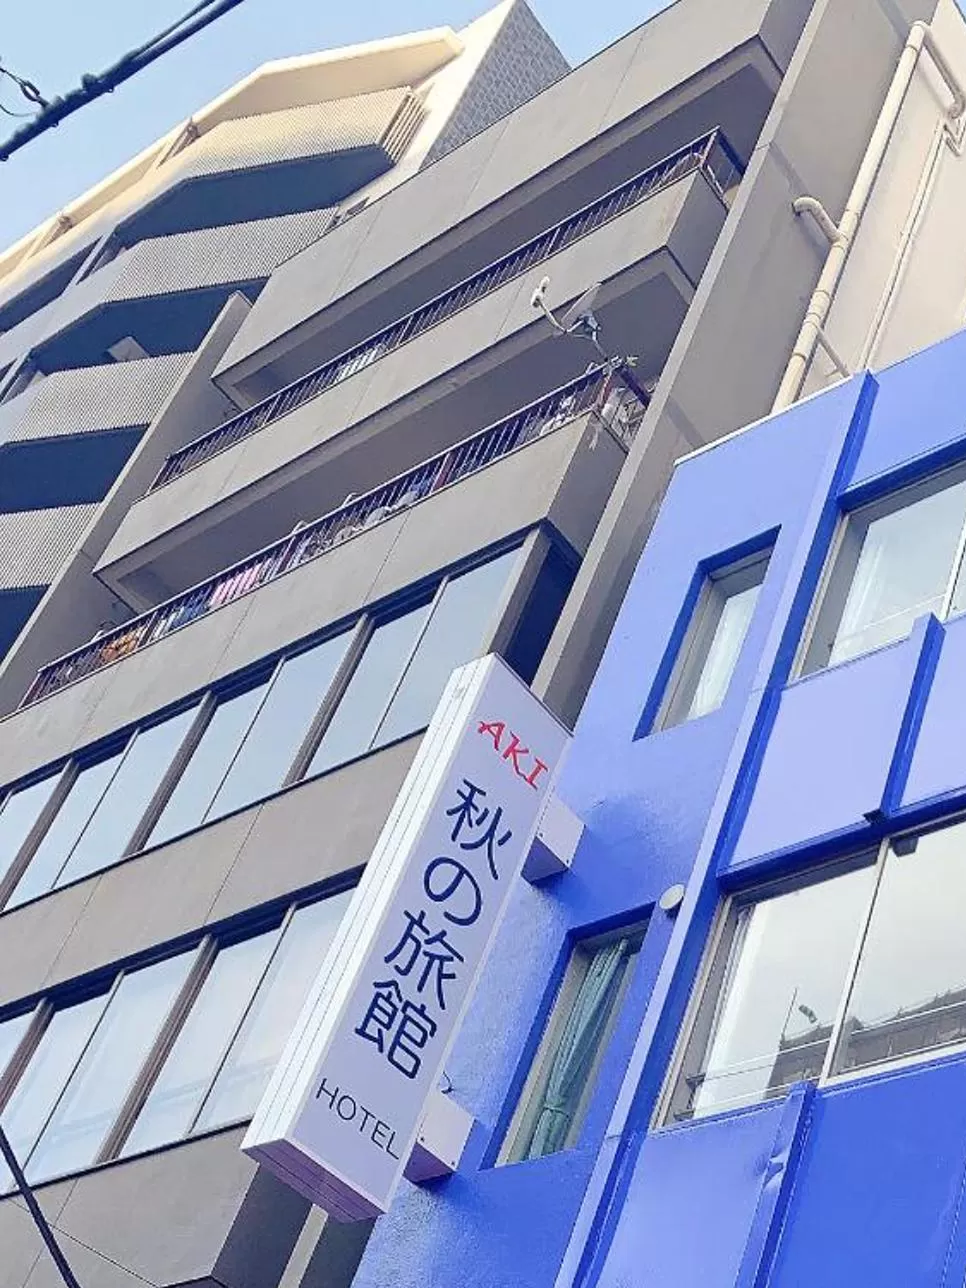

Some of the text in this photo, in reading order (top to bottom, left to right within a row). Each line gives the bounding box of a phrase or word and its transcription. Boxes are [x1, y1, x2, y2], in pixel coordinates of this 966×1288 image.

[477, 719, 550, 790] AKI
[354, 778, 513, 1080] 秋の旅館
[315, 1077, 401, 1160] HOTEL
